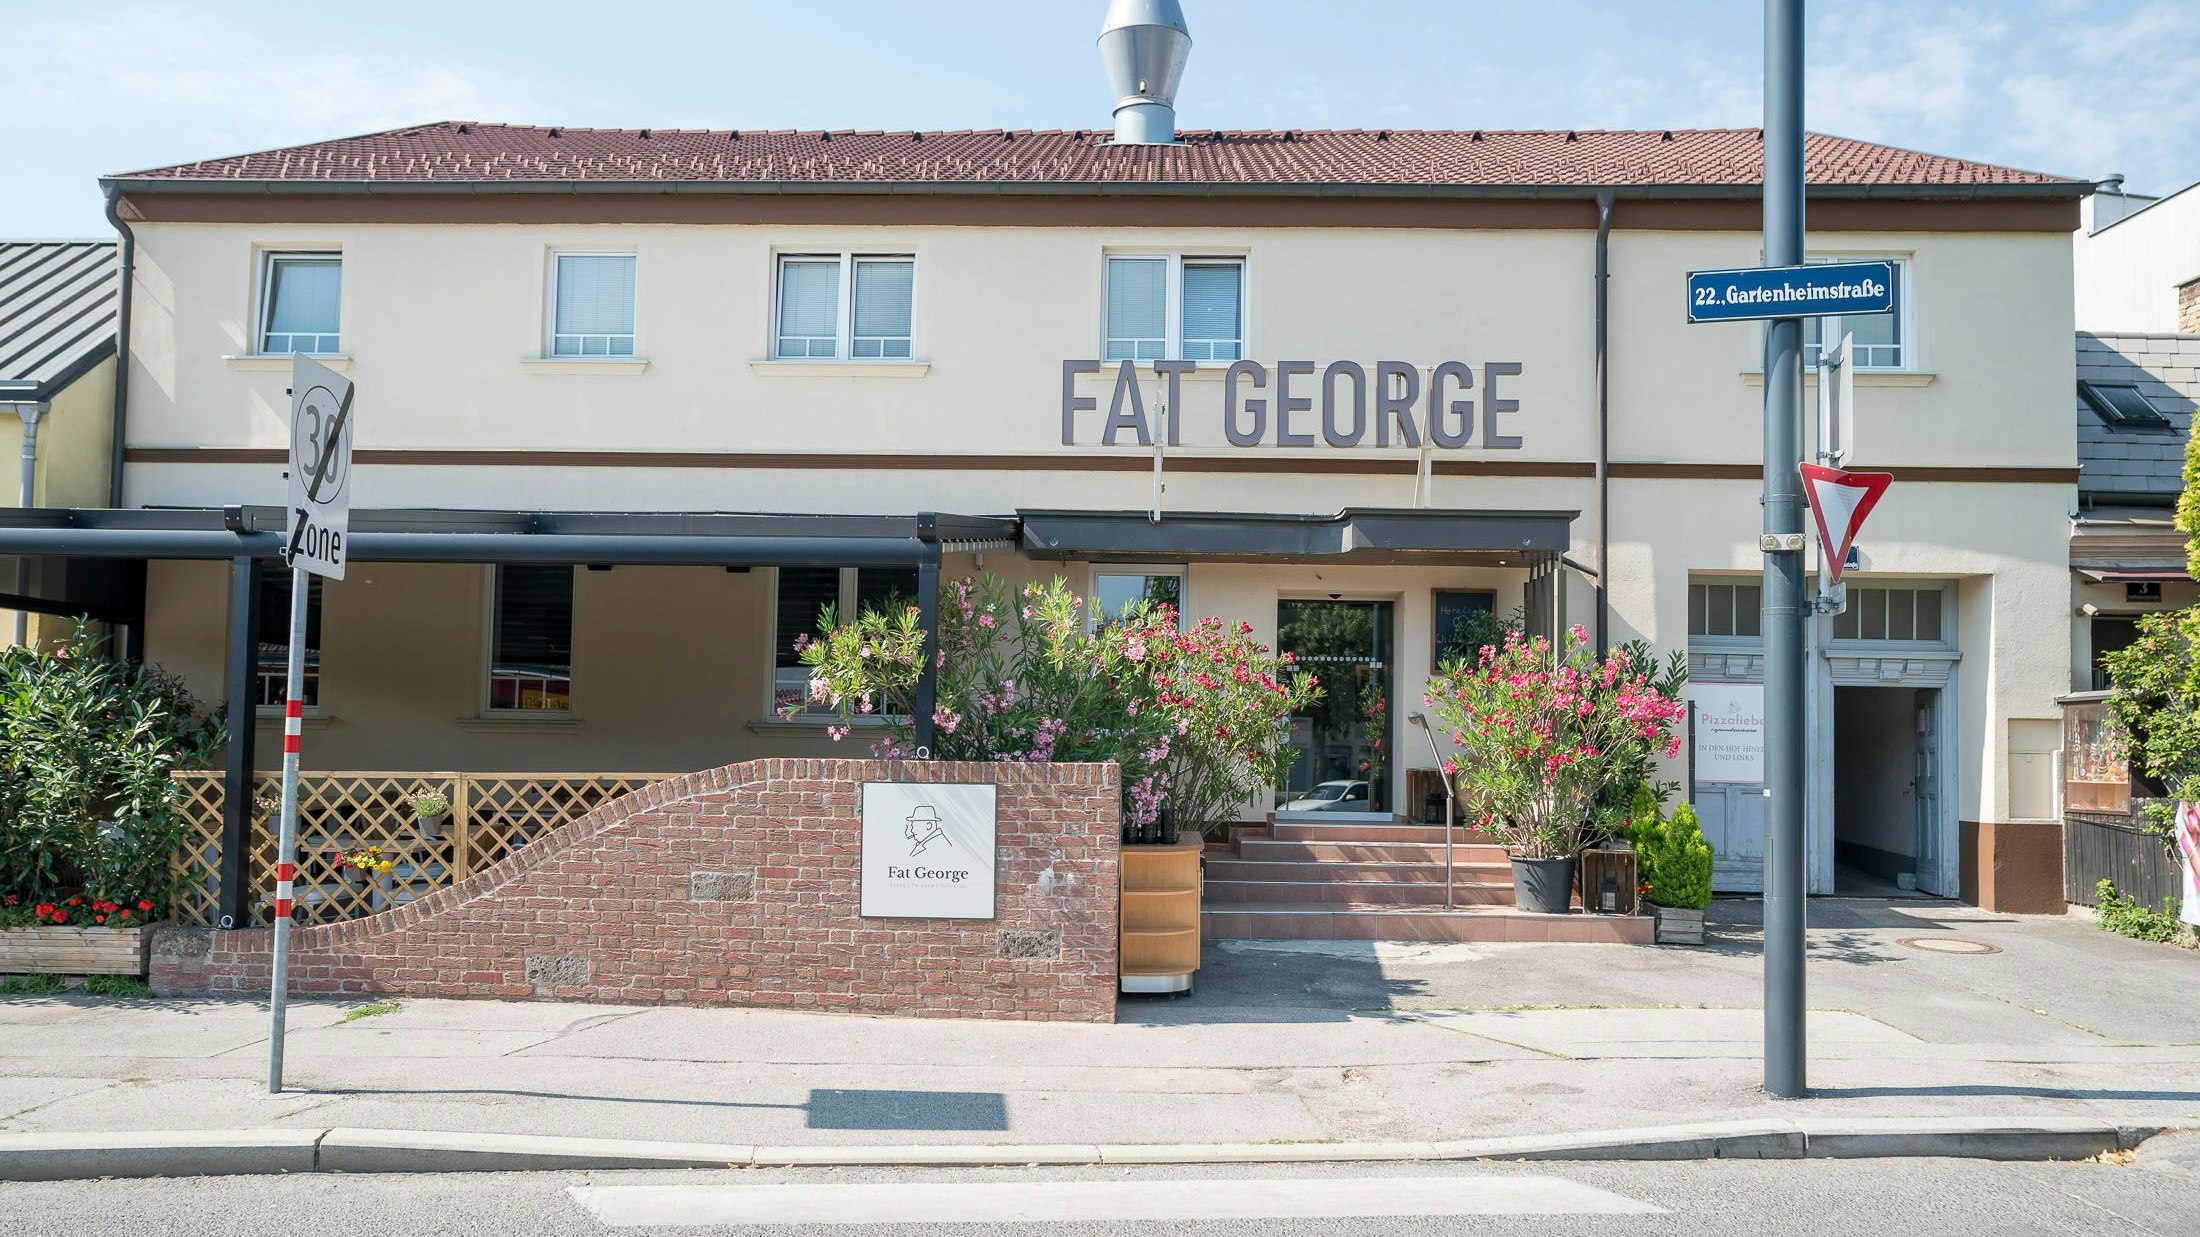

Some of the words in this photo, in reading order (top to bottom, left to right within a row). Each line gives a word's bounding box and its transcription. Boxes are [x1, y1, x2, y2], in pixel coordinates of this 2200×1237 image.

[1062, 359, 1196, 446] FAT
[1224, 359, 1523, 449] GEORGE
[303, 404, 340, 485] 30
[289, 507, 341, 565] Zone
[1698, 744, 1707, 752] IN
[1708, 744, 1725, 752] DEN
[1714, 753, 1731, 761] UND
[888, 865, 911, 879] Fat
[914, 866, 969, 883] George
